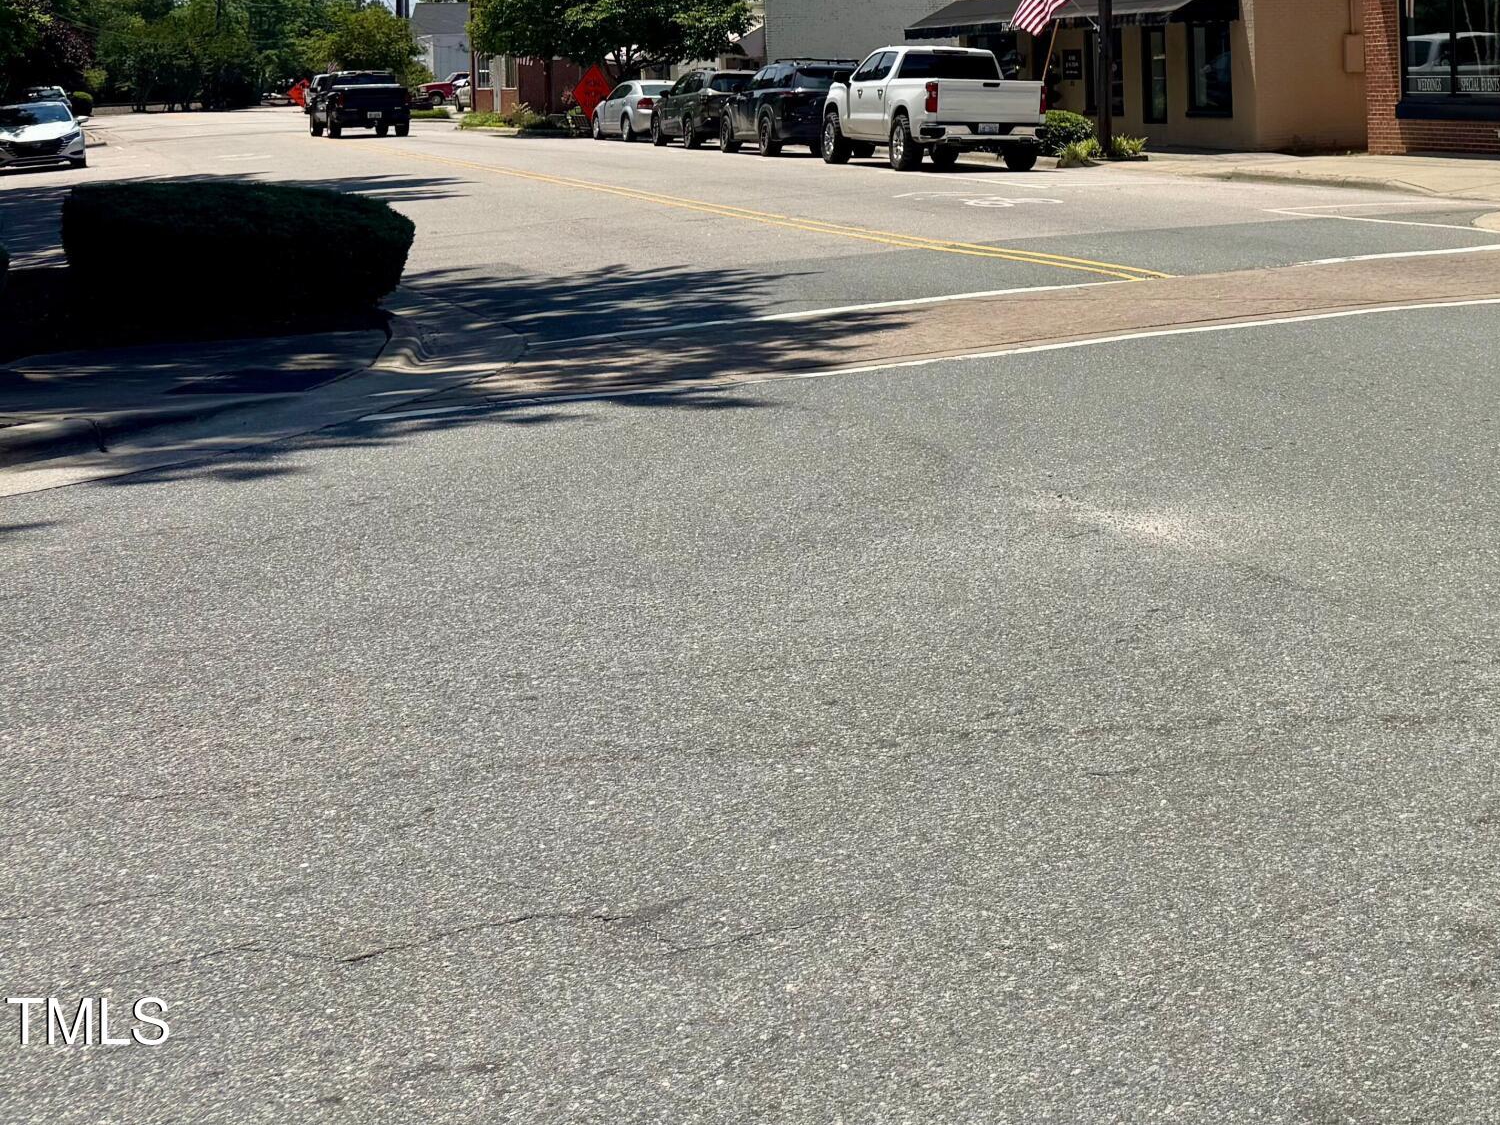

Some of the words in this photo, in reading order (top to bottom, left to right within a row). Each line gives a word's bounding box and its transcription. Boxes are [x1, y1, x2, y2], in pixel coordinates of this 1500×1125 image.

[1416, 78, 1442, 92] WEDDINGS
[1460, 78, 1479, 92] SPECIAL
[1481, 78, 1500, 92] EVENTS
